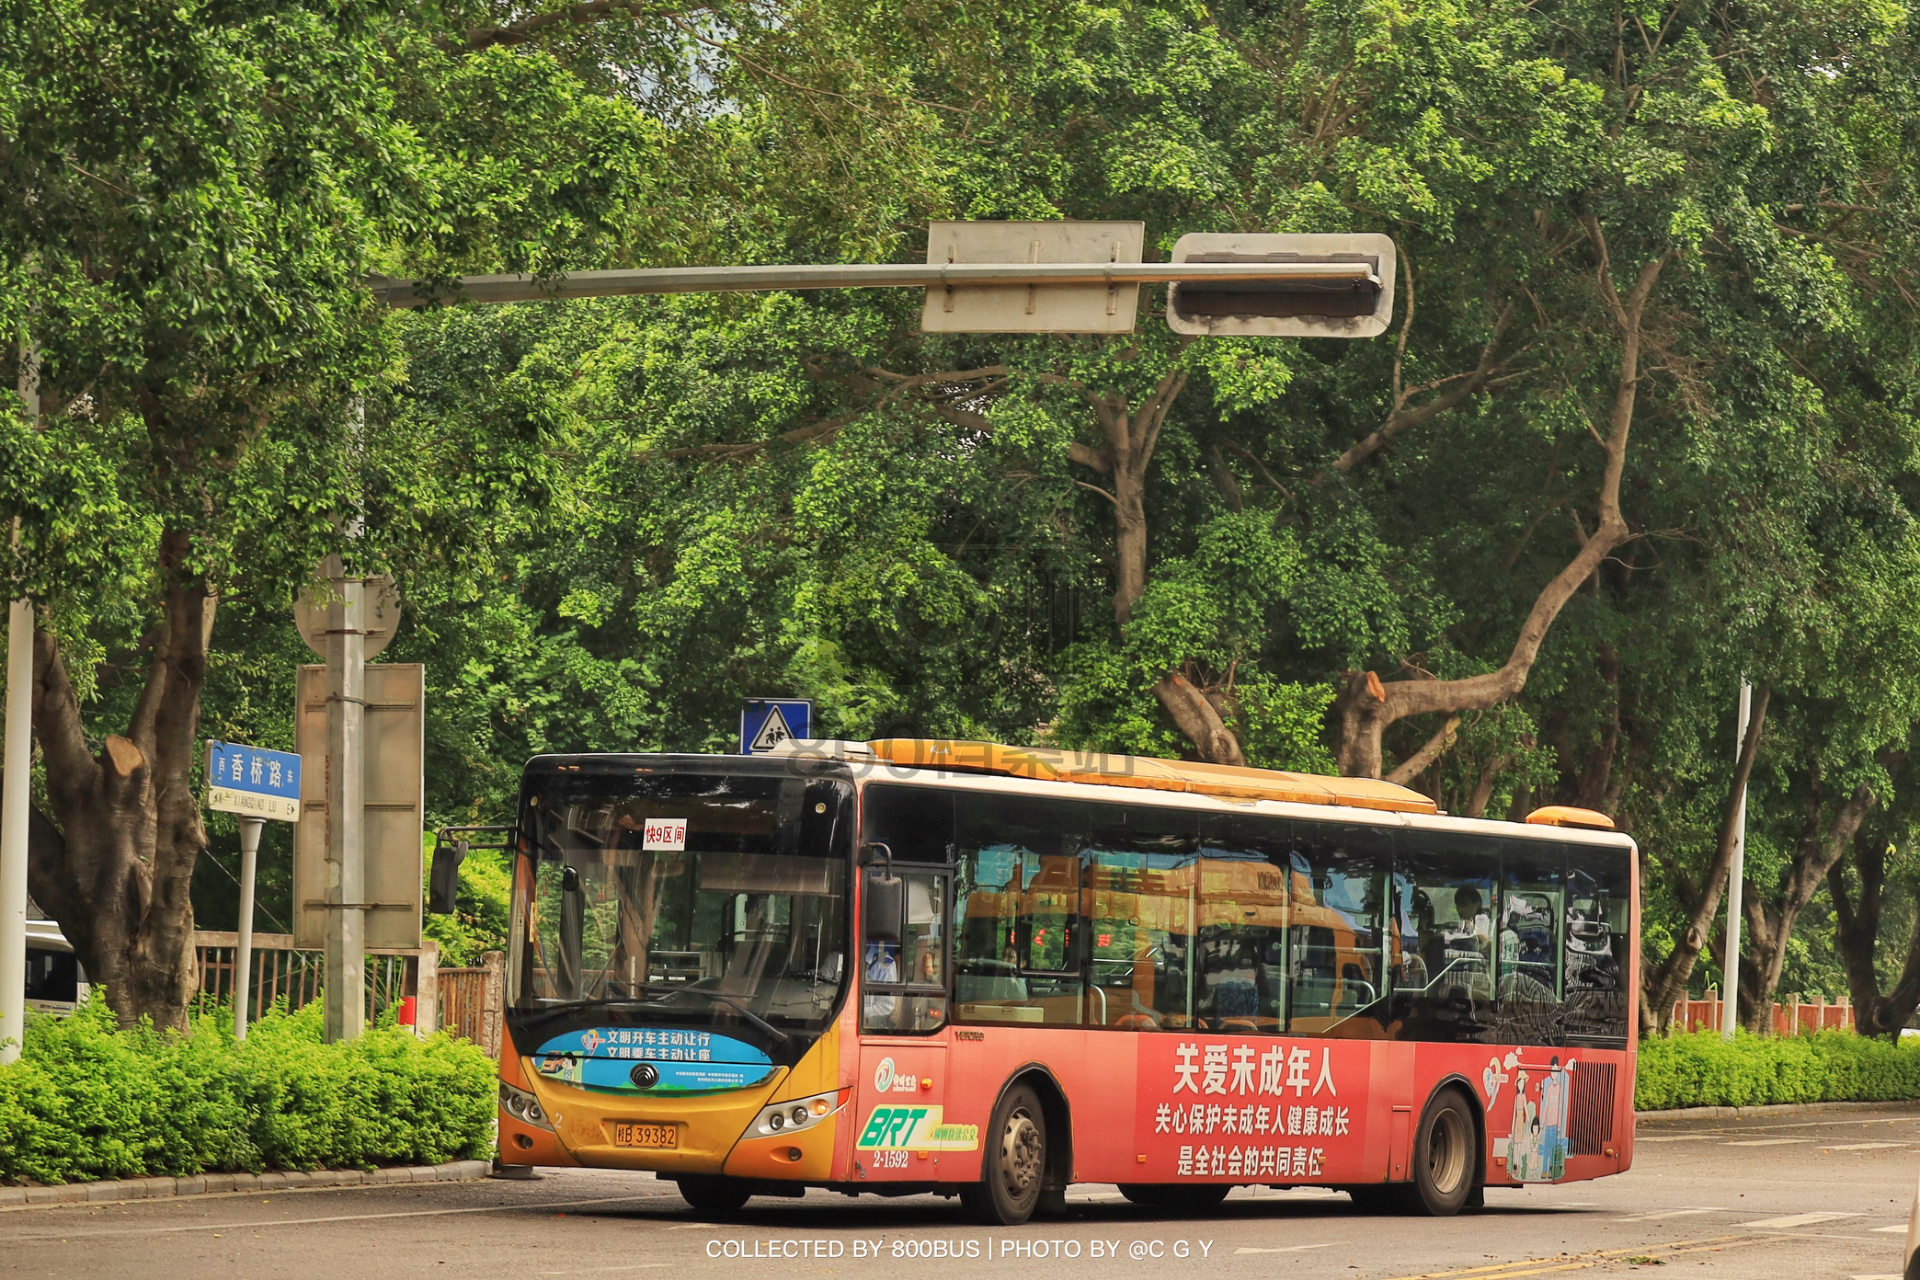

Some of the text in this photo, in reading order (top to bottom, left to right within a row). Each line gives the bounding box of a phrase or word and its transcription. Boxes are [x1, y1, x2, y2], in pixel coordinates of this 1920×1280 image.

[231, 753, 282, 788] 香桥路
[268, 799, 277, 813] LU
[645, 825, 685, 844] 快9区间
[607, 1031, 711, 1047] 文明开车主动让行
[606, 1046, 711, 1062] 文明乘车主动让座
[1172, 1043, 1337, 1098] 关爱未成年人
[858, 1108, 928, 1147] BRT
[1154, 1103, 1350, 1137] 关心保护未成年人健康成长
[873, 1150, 909, 1168] 2-1592
[1176, 1145, 1324, 1178] 是全社会的共同责任
